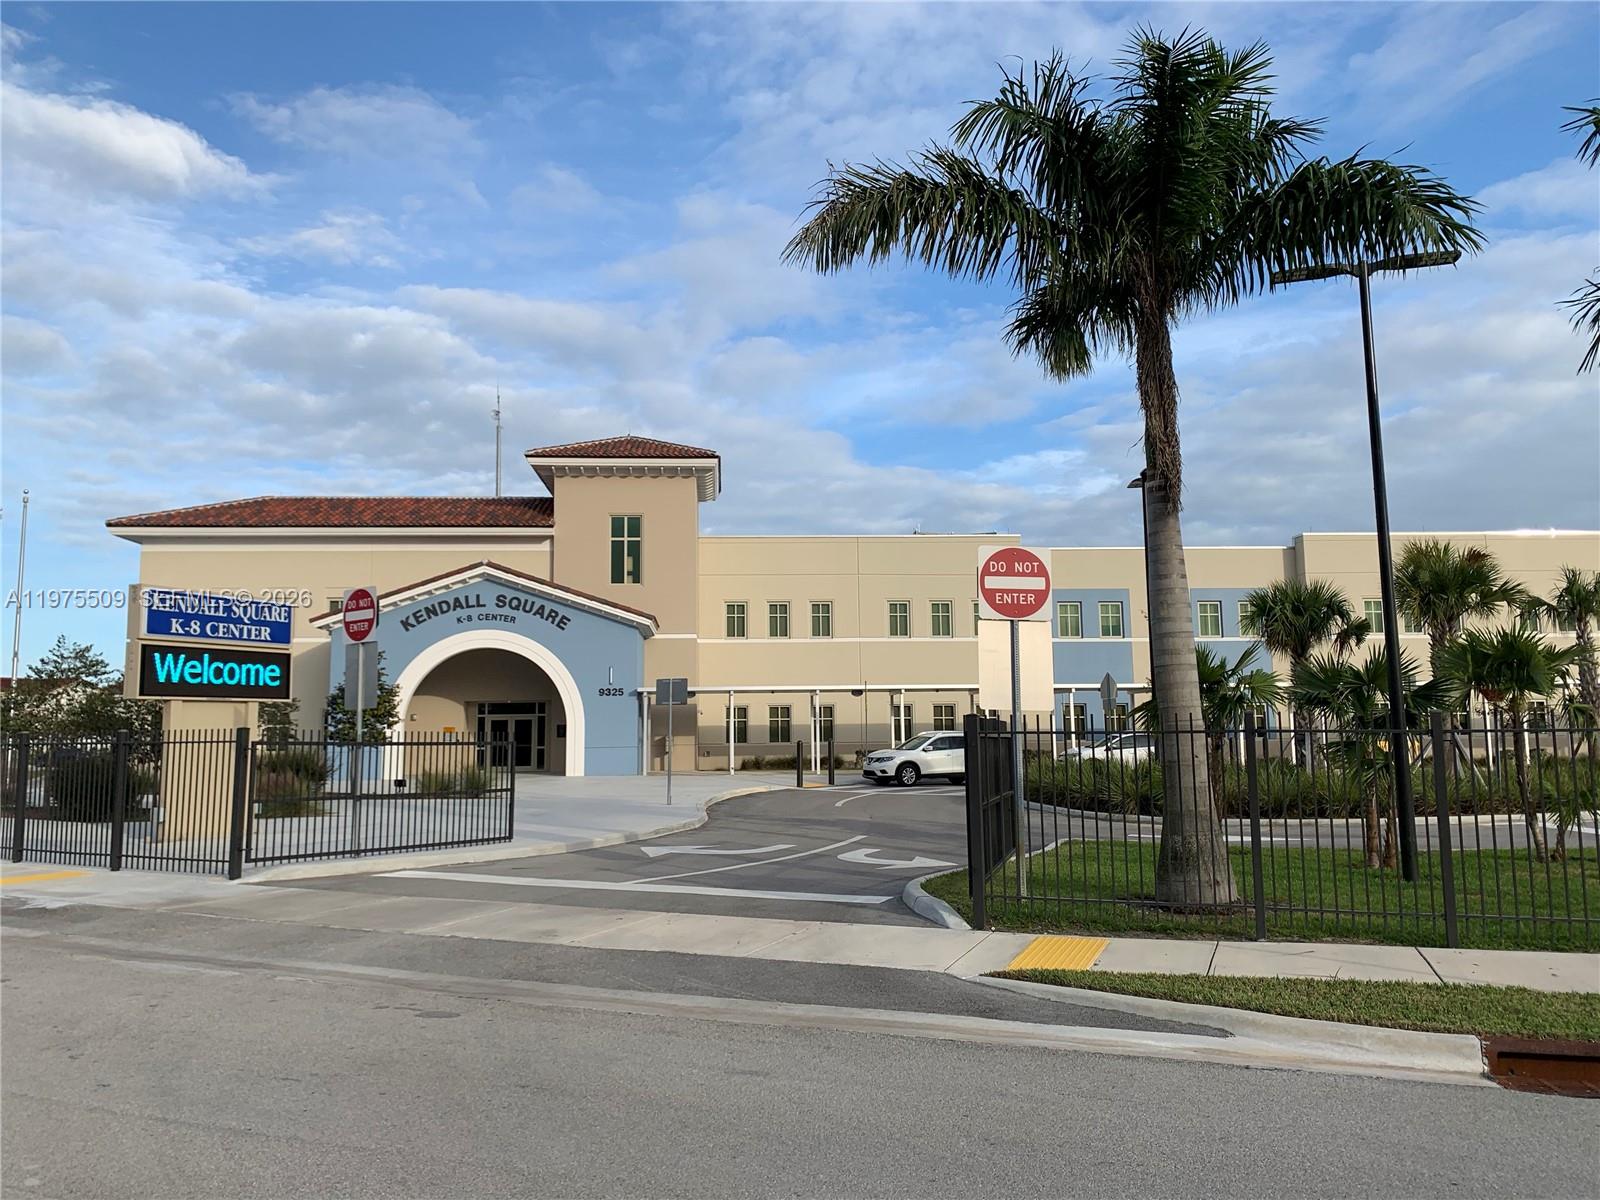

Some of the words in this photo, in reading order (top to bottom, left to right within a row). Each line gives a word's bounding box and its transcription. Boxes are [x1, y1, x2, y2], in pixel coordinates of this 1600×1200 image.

[989, 561, 1006, 573] DO
[1014, 562, 1040, 574] NOT
[347, 600, 357, 609] DO
[359, 597, 372, 607] NOT
[995, 592, 1036, 605] ENTER
[151, 591, 227, 617] KENDALL
[230, 602, 289, 624] SQUARE
[399, 593, 487, 632] KENDALL
[495, 594, 572, 631] SQUARE
[455, 614, 474, 624] K-8
[477, 613, 517, 624] CENTER
[170, 617, 201, 636] K-8
[205, 621, 272, 641] CENTER
[349, 622, 369, 633] ENTER
[153, 652, 281, 687] Welcome
[598, 687, 624, 697] 9325
